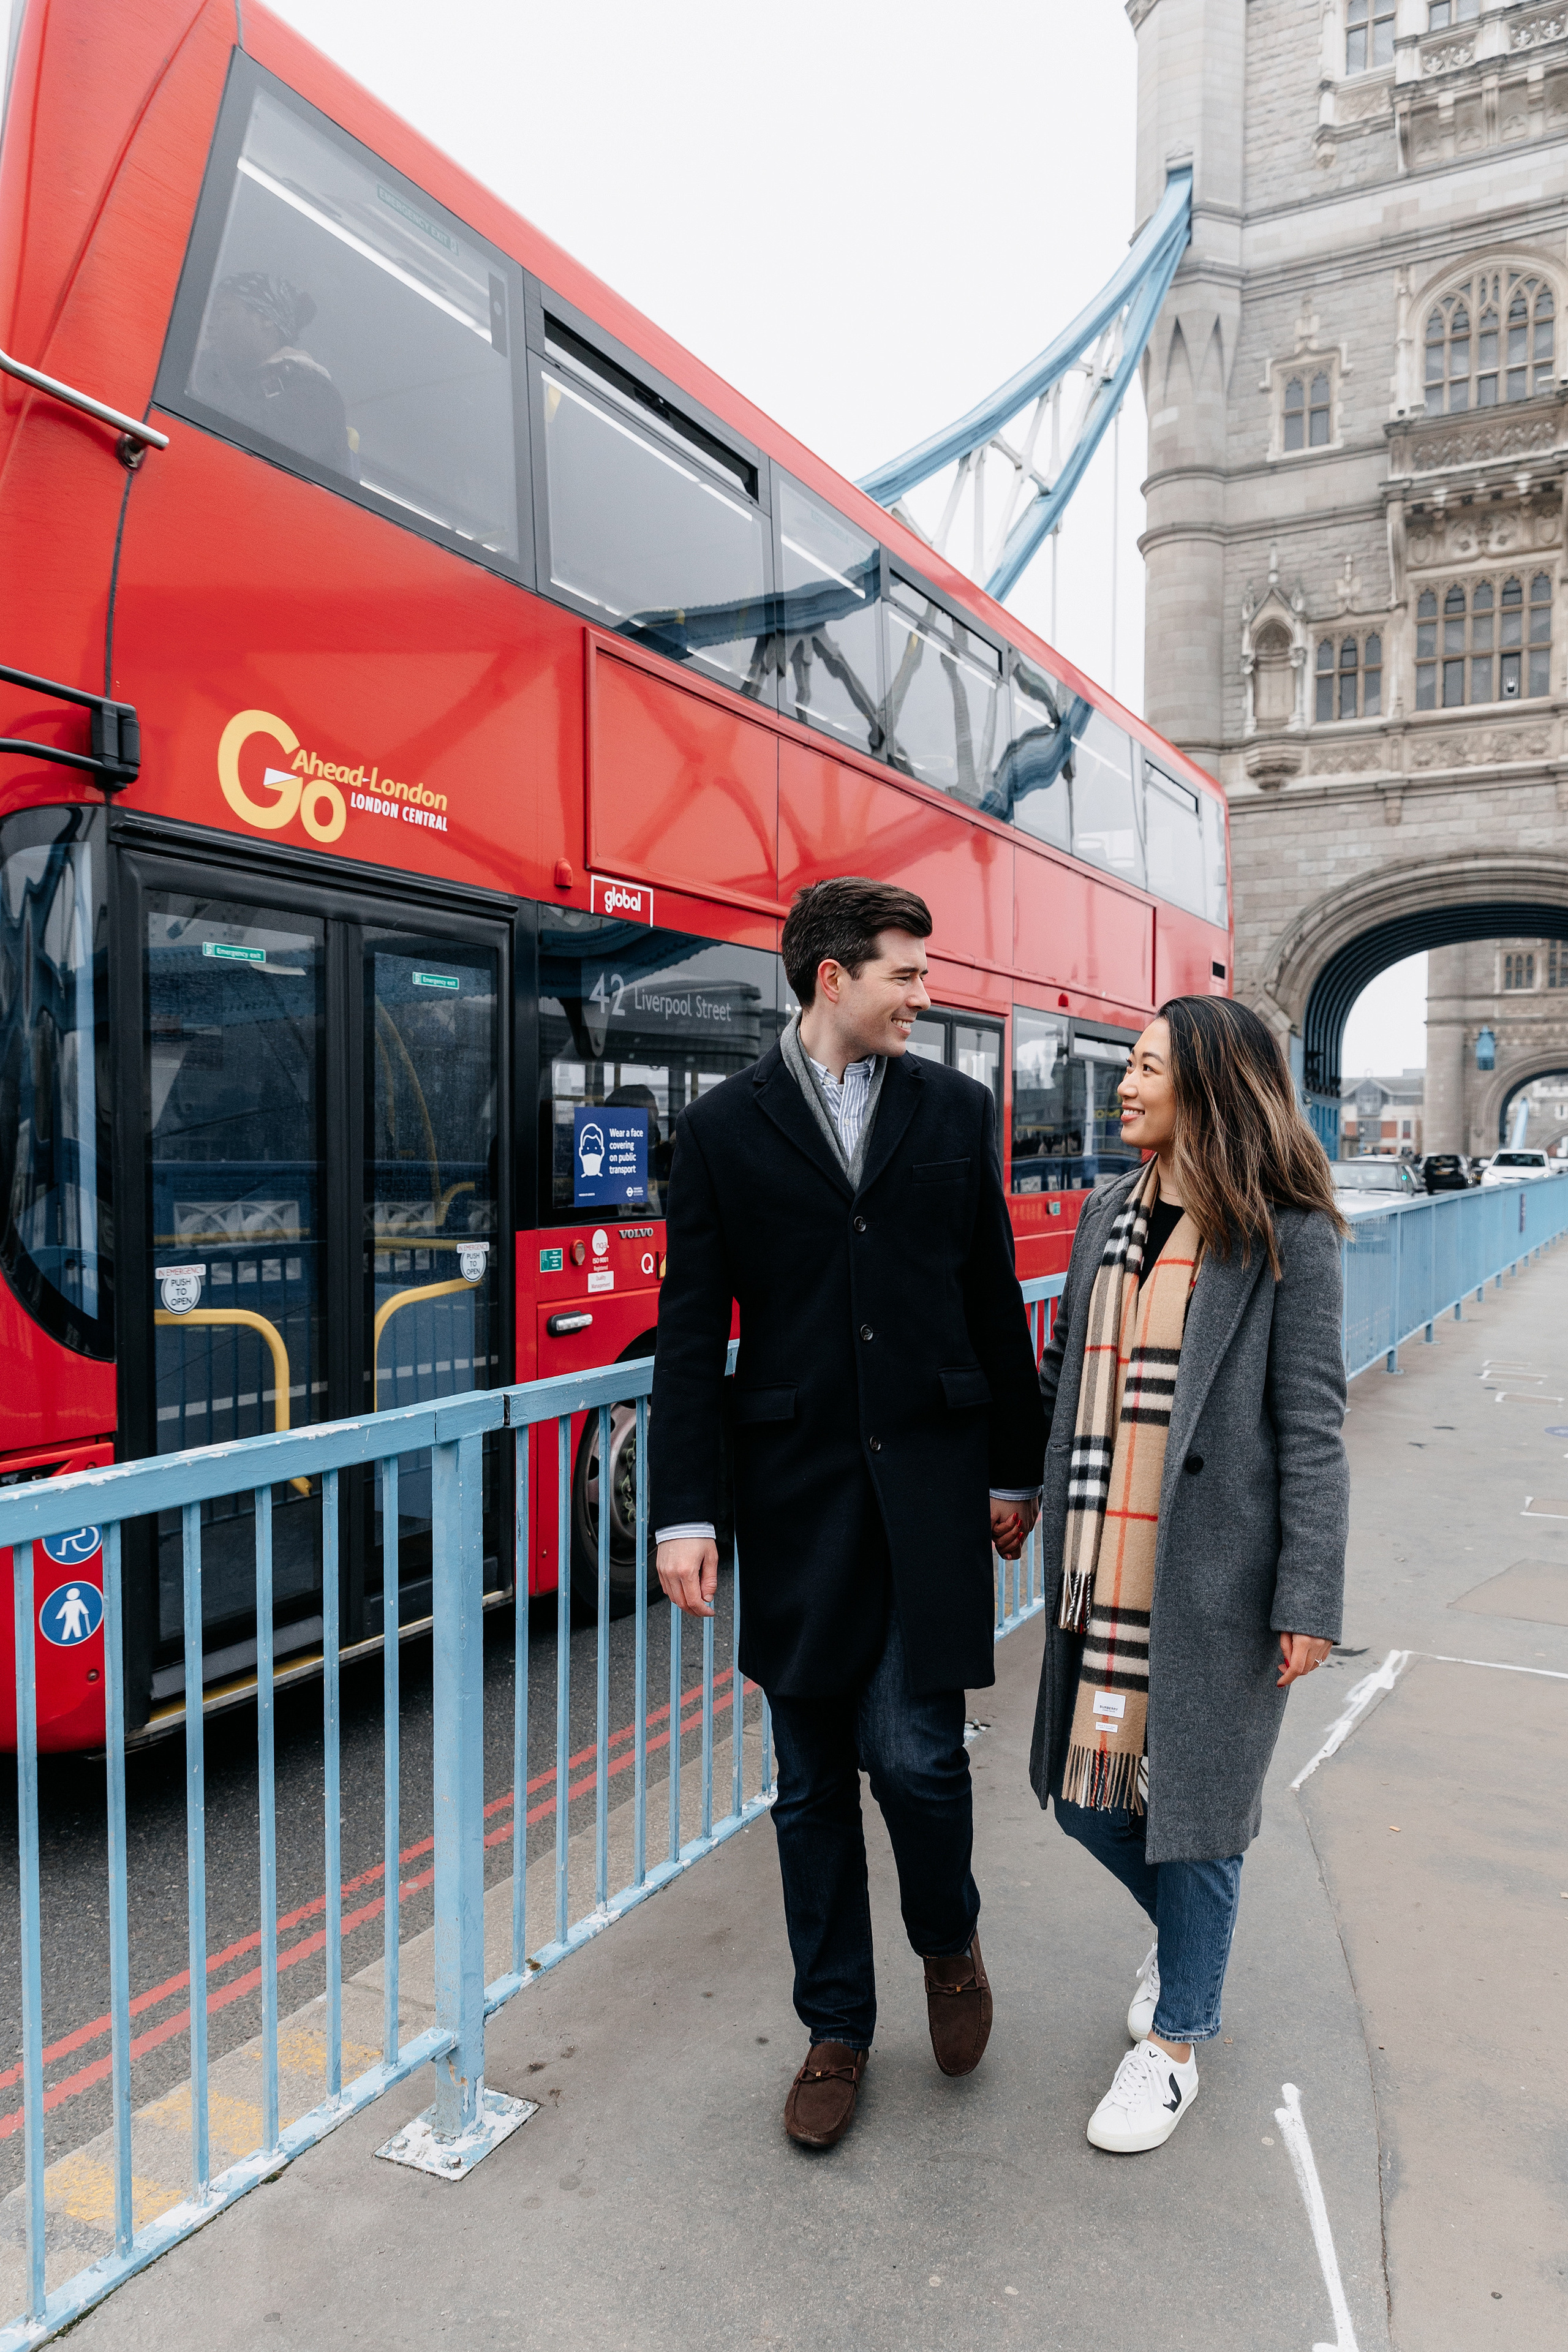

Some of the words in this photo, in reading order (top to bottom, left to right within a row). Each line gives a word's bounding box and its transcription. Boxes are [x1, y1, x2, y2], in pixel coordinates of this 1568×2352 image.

[379, 186, 429, 230] EMERGENCY
[431, 225, 448, 247] EXIT
[217, 709, 347, 843] Go
[350, 792, 399, 819] LONDON
[402, 807, 448, 832] CENTRAL
[604, 886, 641, 913] global
[216, 948, 249, 959] Emergency
[423, 976, 447, 986] Emergency
[589, 971, 625, 1016] 42
[635, 985, 692, 1020] Liverpool
[696, 995, 732, 1022] Street
[609, 1128, 625, 1137] Wear
[630, 1128, 644, 1137] face
[609, 1140, 635, 1152] covering
[618, 1152, 636, 1164] public
[609, 1165, 636, 1176] transport
[619, 1227, 654, 1239] VOLVO
[641, 1253, 654, 1275] Q
[166, 1266, 204, 1276] EMERGENCY
[171, 1278, 192, 1287] PUSH
[170, 1297, 193, 1306] OPEN
